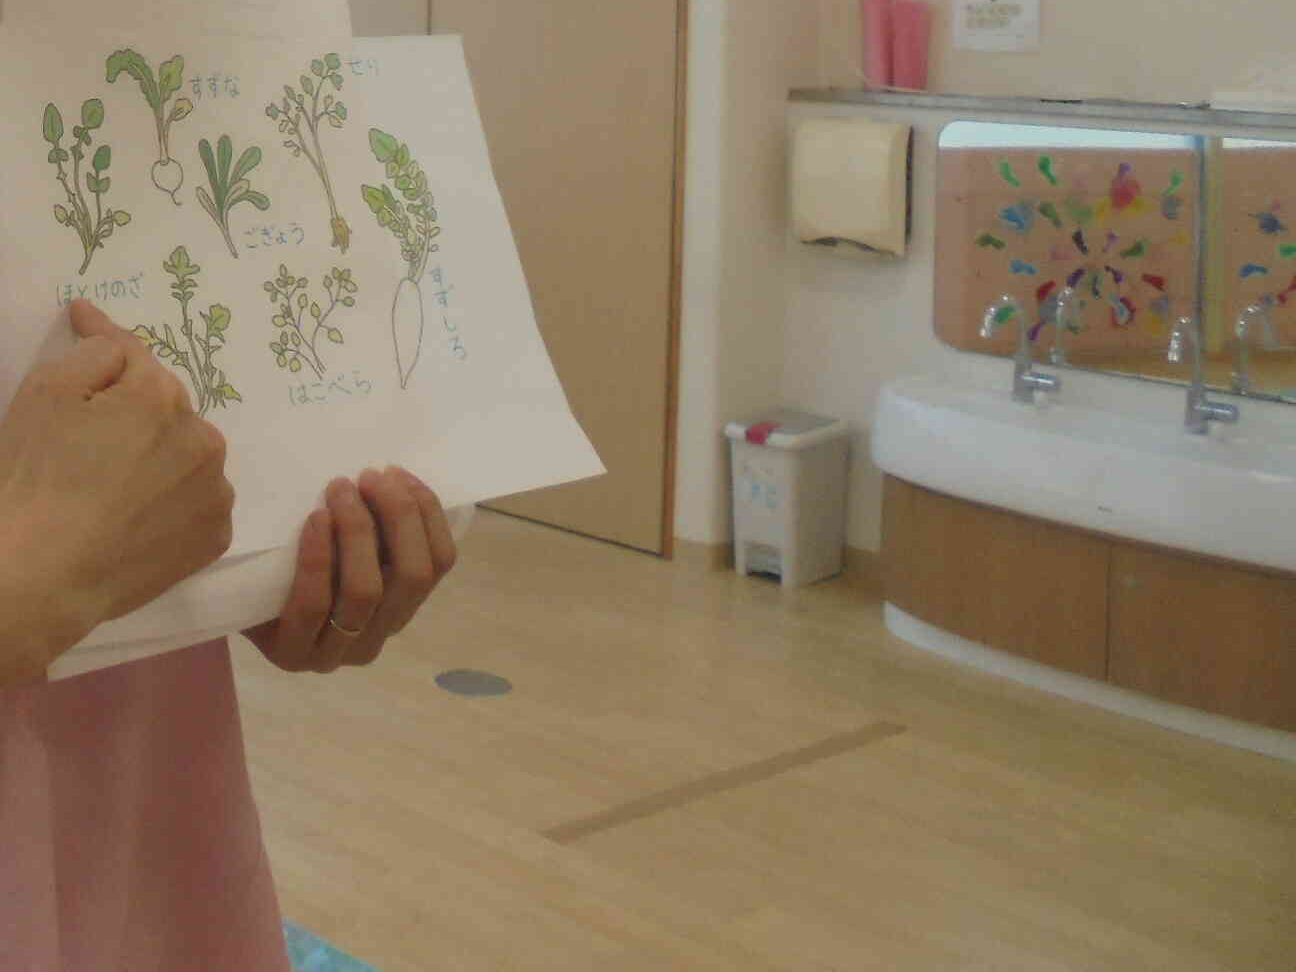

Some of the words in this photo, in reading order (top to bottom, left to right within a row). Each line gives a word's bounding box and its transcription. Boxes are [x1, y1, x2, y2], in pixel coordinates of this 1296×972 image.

[243, 221, 305, 249] ごぎょう
[428, 264, 467, 359] すずしろ
[288, 372, 371, 405] はこべら
